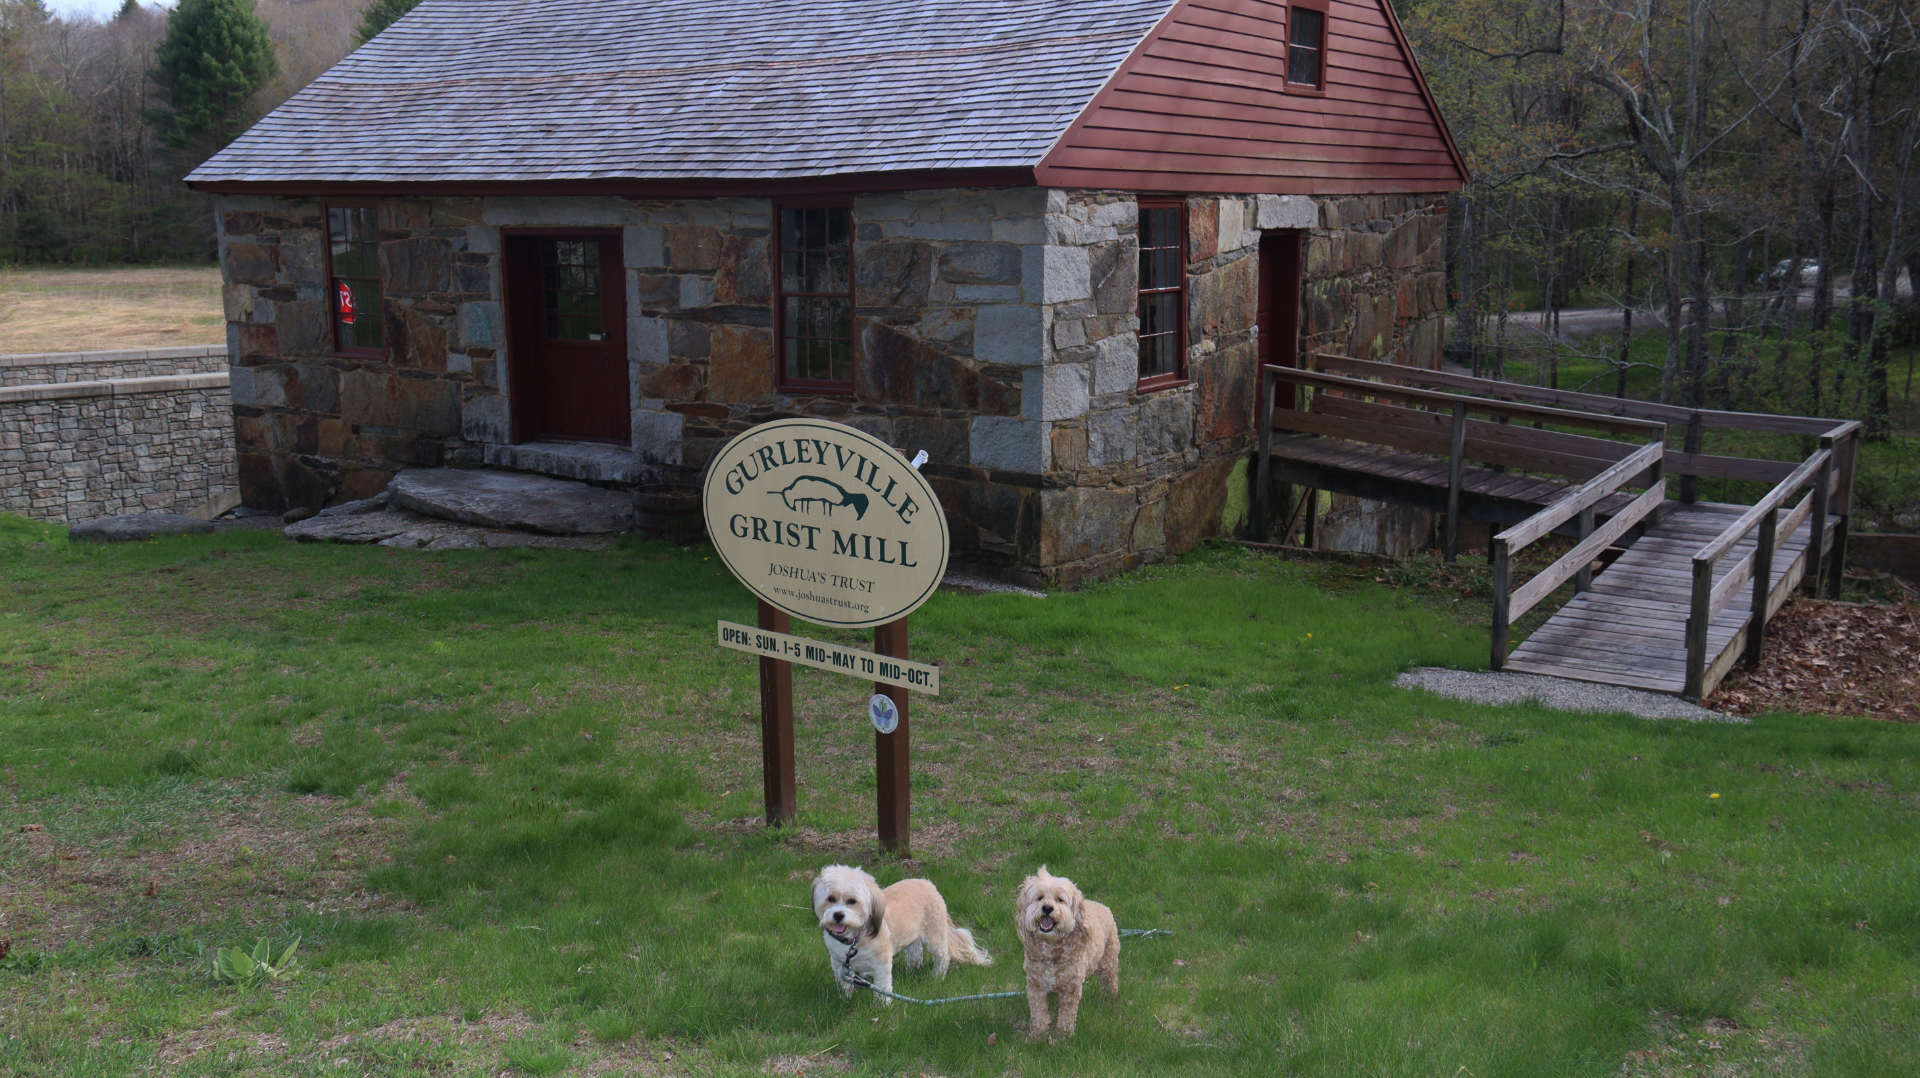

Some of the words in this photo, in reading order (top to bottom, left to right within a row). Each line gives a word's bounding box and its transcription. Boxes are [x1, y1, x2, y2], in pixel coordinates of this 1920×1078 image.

[725, 438, 920, 525] GURLEYVILLE
[729, 513, 821, 551] GRIST
[832, 529, 918, 568] MILL
[768, 562, 827, 584] JOSHUA'S
[831, 574, 876, 593] TRUST
[773, 586, 870, 614] www.joshuastrust.org
[722, 627, 751, 646] OPEN:
[756, 634, 780, 653] SUN.
[783, 640, 801, 657] 1-5
[805, 645, 856, 670] MID-MAY
[861, 657, 874, 674] TO
[879, 661, 934, 688] MID-OCT.
